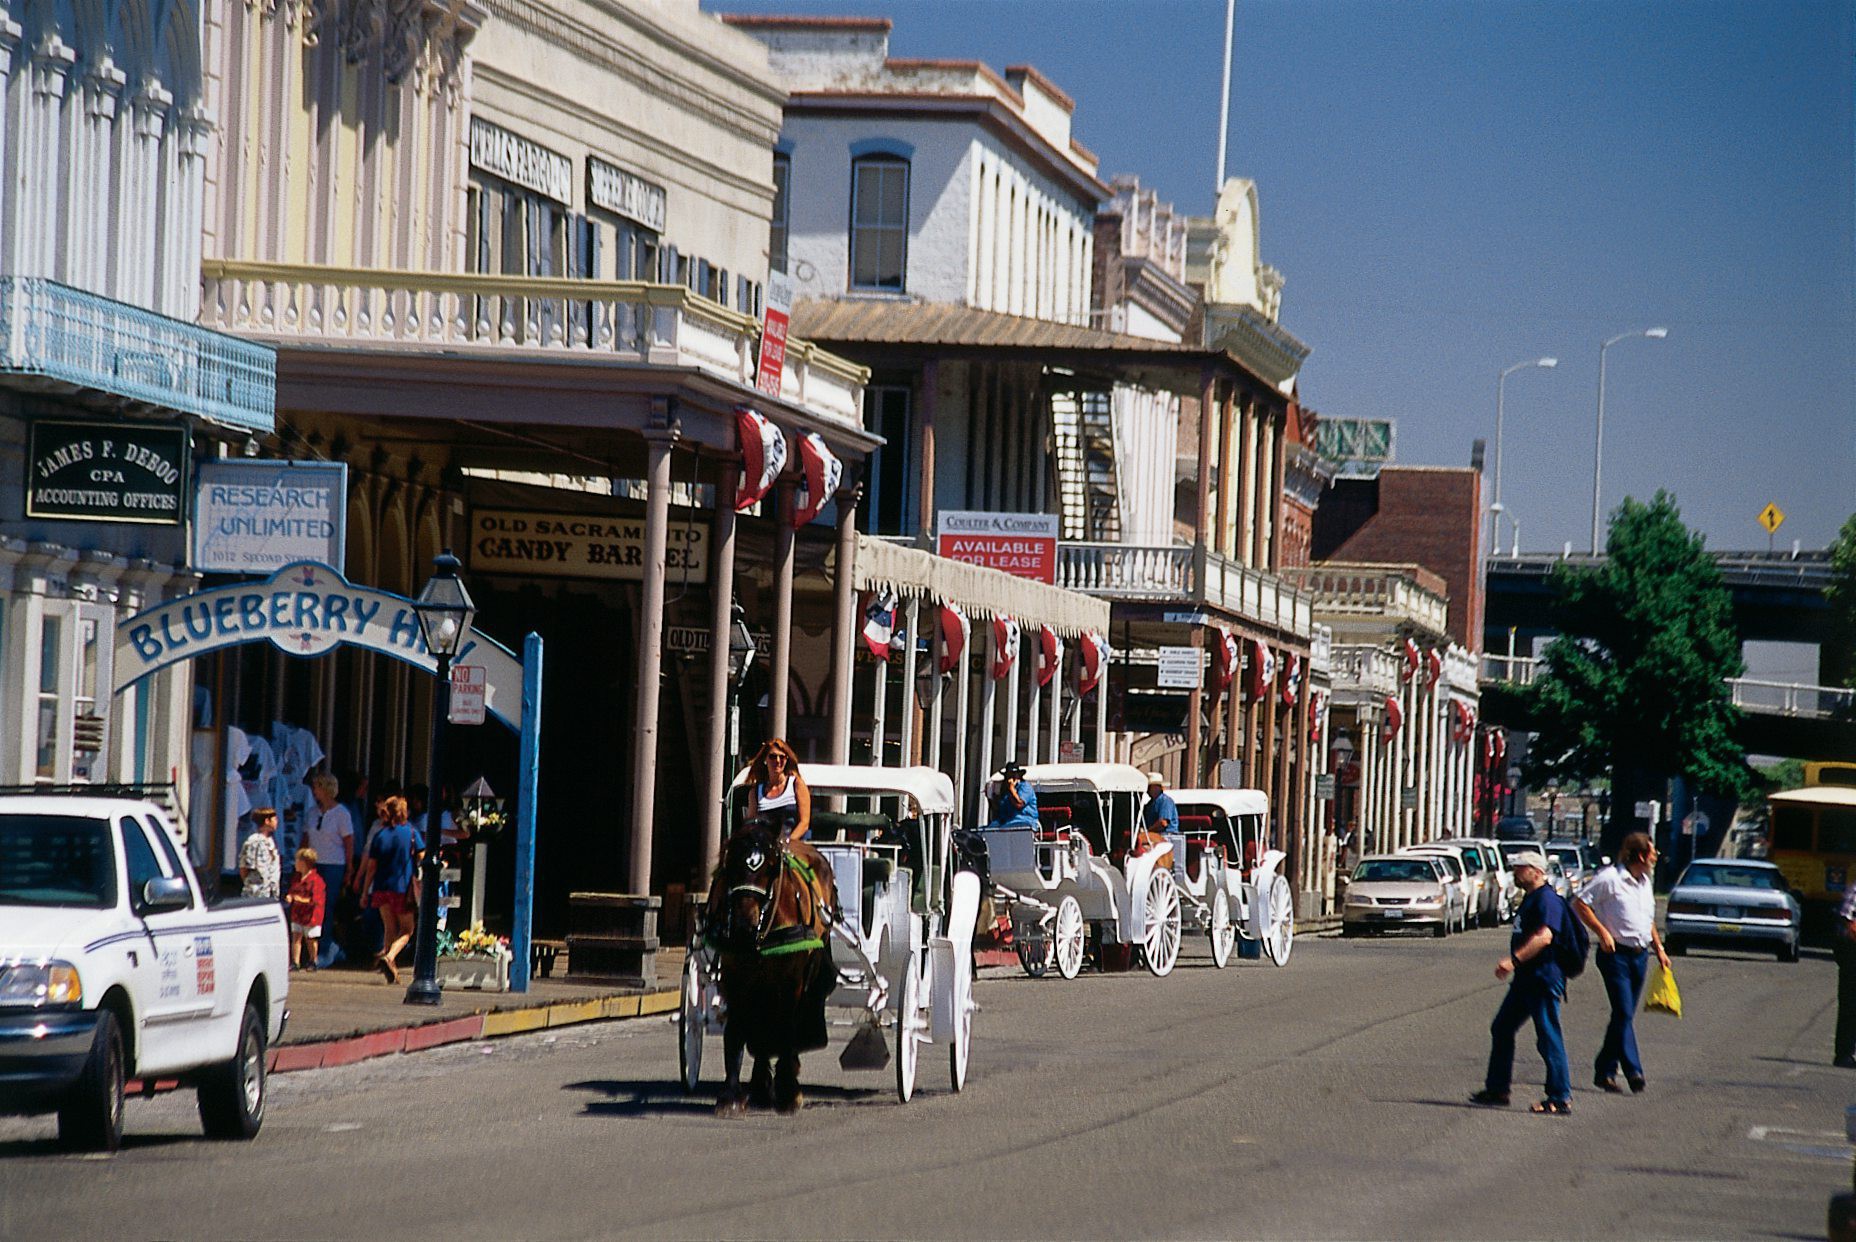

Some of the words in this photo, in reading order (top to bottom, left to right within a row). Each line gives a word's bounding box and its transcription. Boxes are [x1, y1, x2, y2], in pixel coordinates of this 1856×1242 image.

[37, 441, 93, 478] JAMES
[101, 440, 116, 458] F.
[124, 443, 179, 485] DEBOO
[90, 469, 125, 483] CPA
[36, 488, 118, 507] ACCOUNTING
[123, 492, 177, 510] OFFICES
[211, 486, 330, 509] RESEARCH
[220, 515, 335, 538] UNLIMITED
[480, 517, 527, 534] OLD
[535, 519, 702, 543] SACRAMTO
[478, 538, 573, 562] CANDY
[587, 543, 699, 569] BAREL
[952, 541, 1044, 554] AVAILABLE
[990, 555, 1041, 568] LEASE
[129, 591, 380, 663] BLUEBERRY
[453, 668, 468, 682] NO
